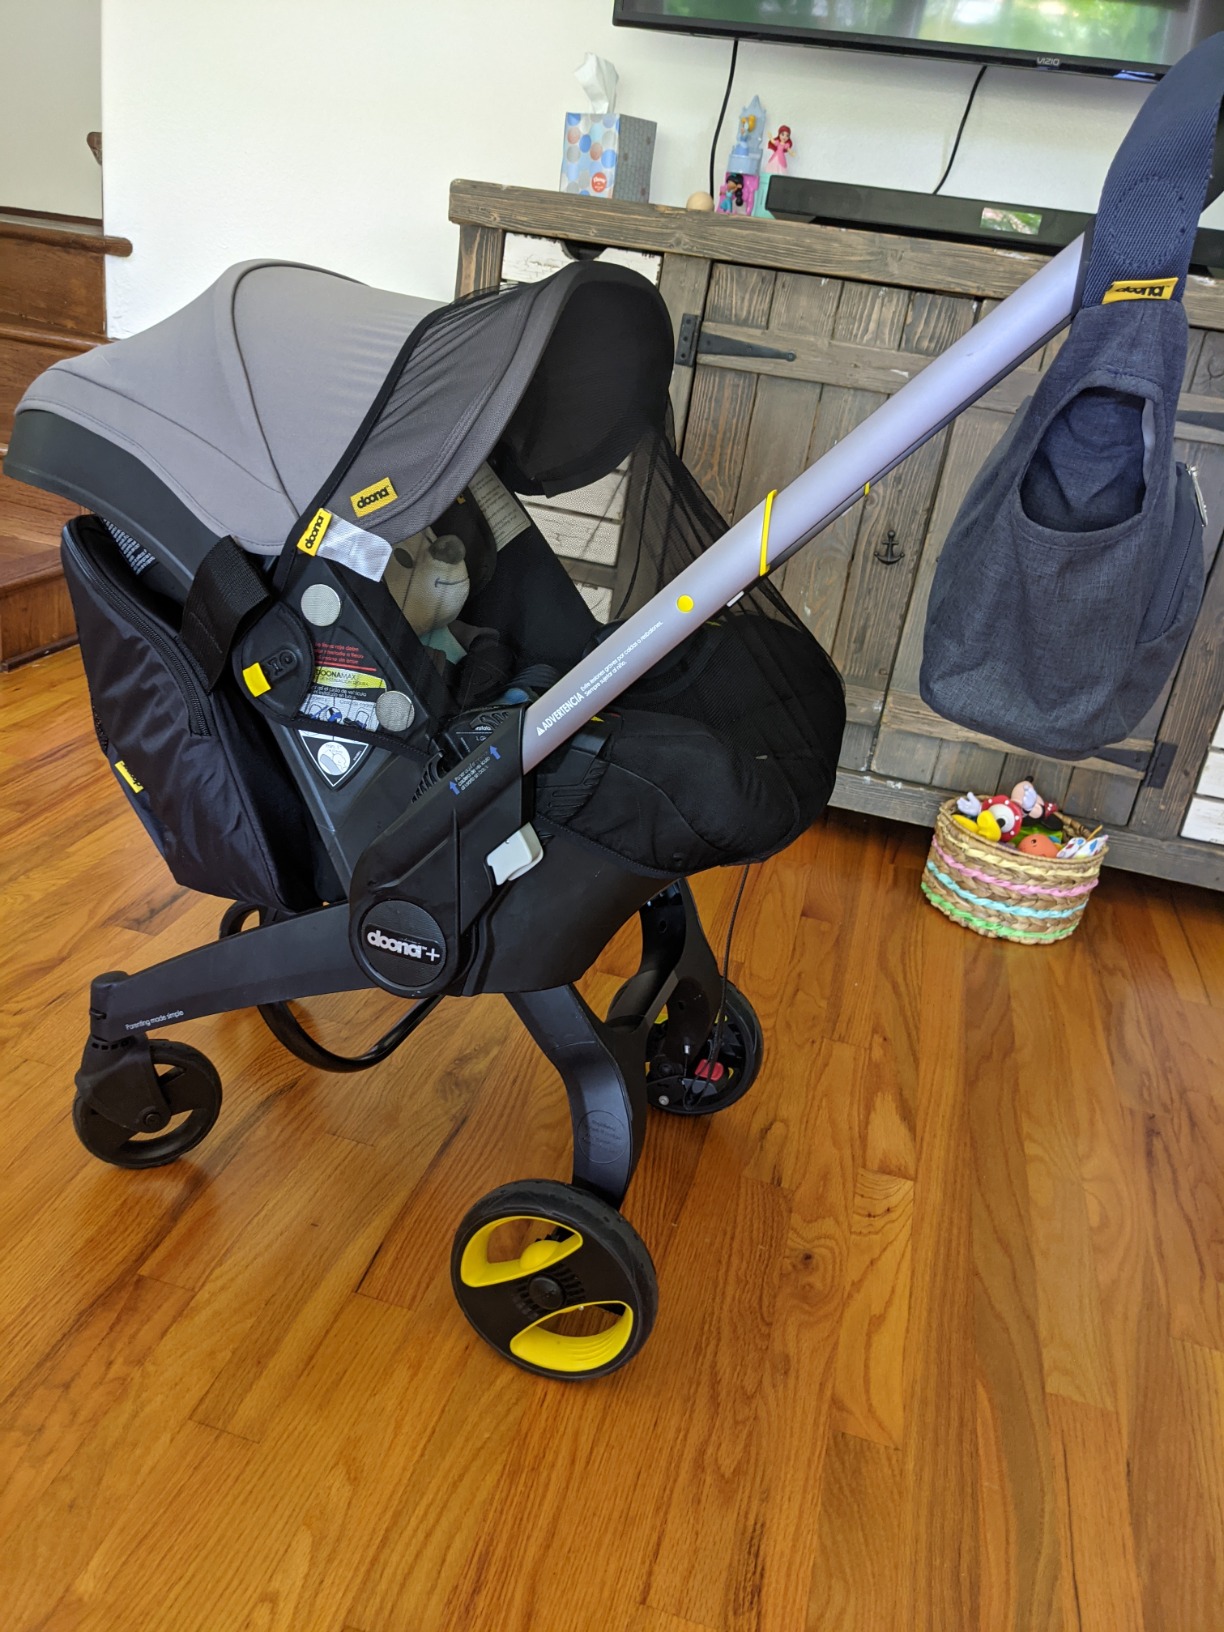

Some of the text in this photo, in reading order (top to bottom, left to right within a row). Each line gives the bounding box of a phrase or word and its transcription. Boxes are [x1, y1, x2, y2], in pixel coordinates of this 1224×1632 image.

[1036, 56, 1060, 66] VIZIO
[356, 486, 390, 510] doona
[304, 515, 325, 549] doona
[541, 692, 585, 731] ADVERTENCIA
[125, 1009, 185, 1031] Parenting made simple
